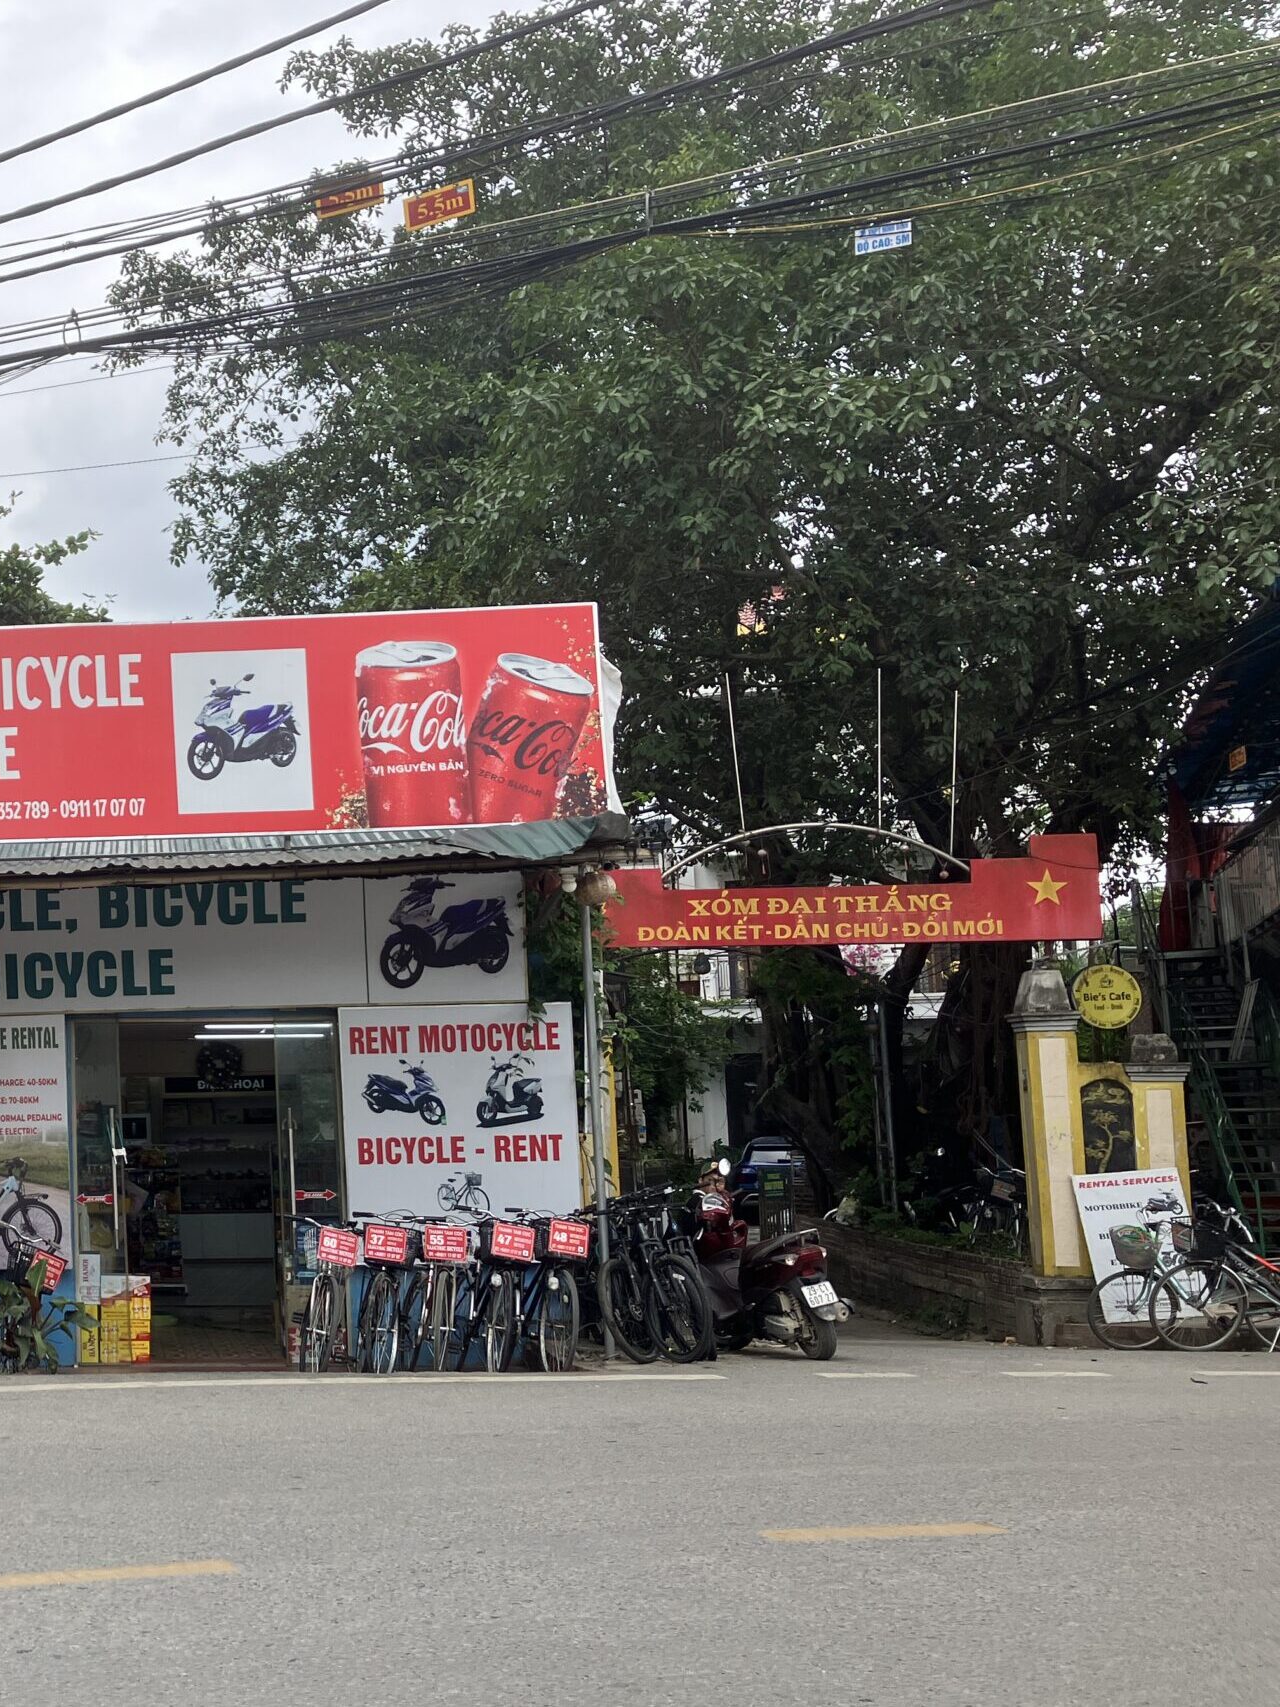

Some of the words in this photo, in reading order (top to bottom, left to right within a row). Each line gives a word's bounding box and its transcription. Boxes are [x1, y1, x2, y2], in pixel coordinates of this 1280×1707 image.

[417, 194, 464, 219] 5.5m
[872, 237, 893, 249] CAO:
[896, 234, 910, 245] 5M
[387, 761, 435, 775] NGUYÊN
[438, 759, 464, 772] BẢN
[478, 769, 505, 785] ZERO
[23, 800, 50, 819] 789
[59, 799, 91, 819] 0911
[92, 798, 108, 817] 17
[109, 798, 127, 817] 07
[129, 797, 146, 817] 07
[98, 880, 308, 930] BICYCLE
[687, 889, 761, 917] XÓM
[832, 885, 953, 914] THẮNG
[637, 920, 710, 942] ĐOÀN
[953, 912, 1004, 936] MỚI
[1109, 991, 1131, 1001] Cafe
[11, 1026, 59, 1050] RENTAL
[349, 1026, 410, 1054] RENT
[418, 1022, 561, 1053] MOTOCYCLE
[26, 1112, 63, 1122] PEDALING
[5, 1126, 39, 1136] ELECTRIC
[358, 1136, 466, 1165] BICYCLE
[494, 1134, 562, 1162] RENT
[1078, 1180, 1121, 1189] RENTAL
[1122, 1175, 1178, 1186] SERVICES:
[1084, 1201, 1143, 1213] MOTORBIKE
[322, 1236, 337, 1249] 60
[369, 1234, 385, 1245] 37
[429, 1235, 445, 1246] 55
[496, 1234, 512, 1245] 47
[553, 1231, 568, 1243] 48
